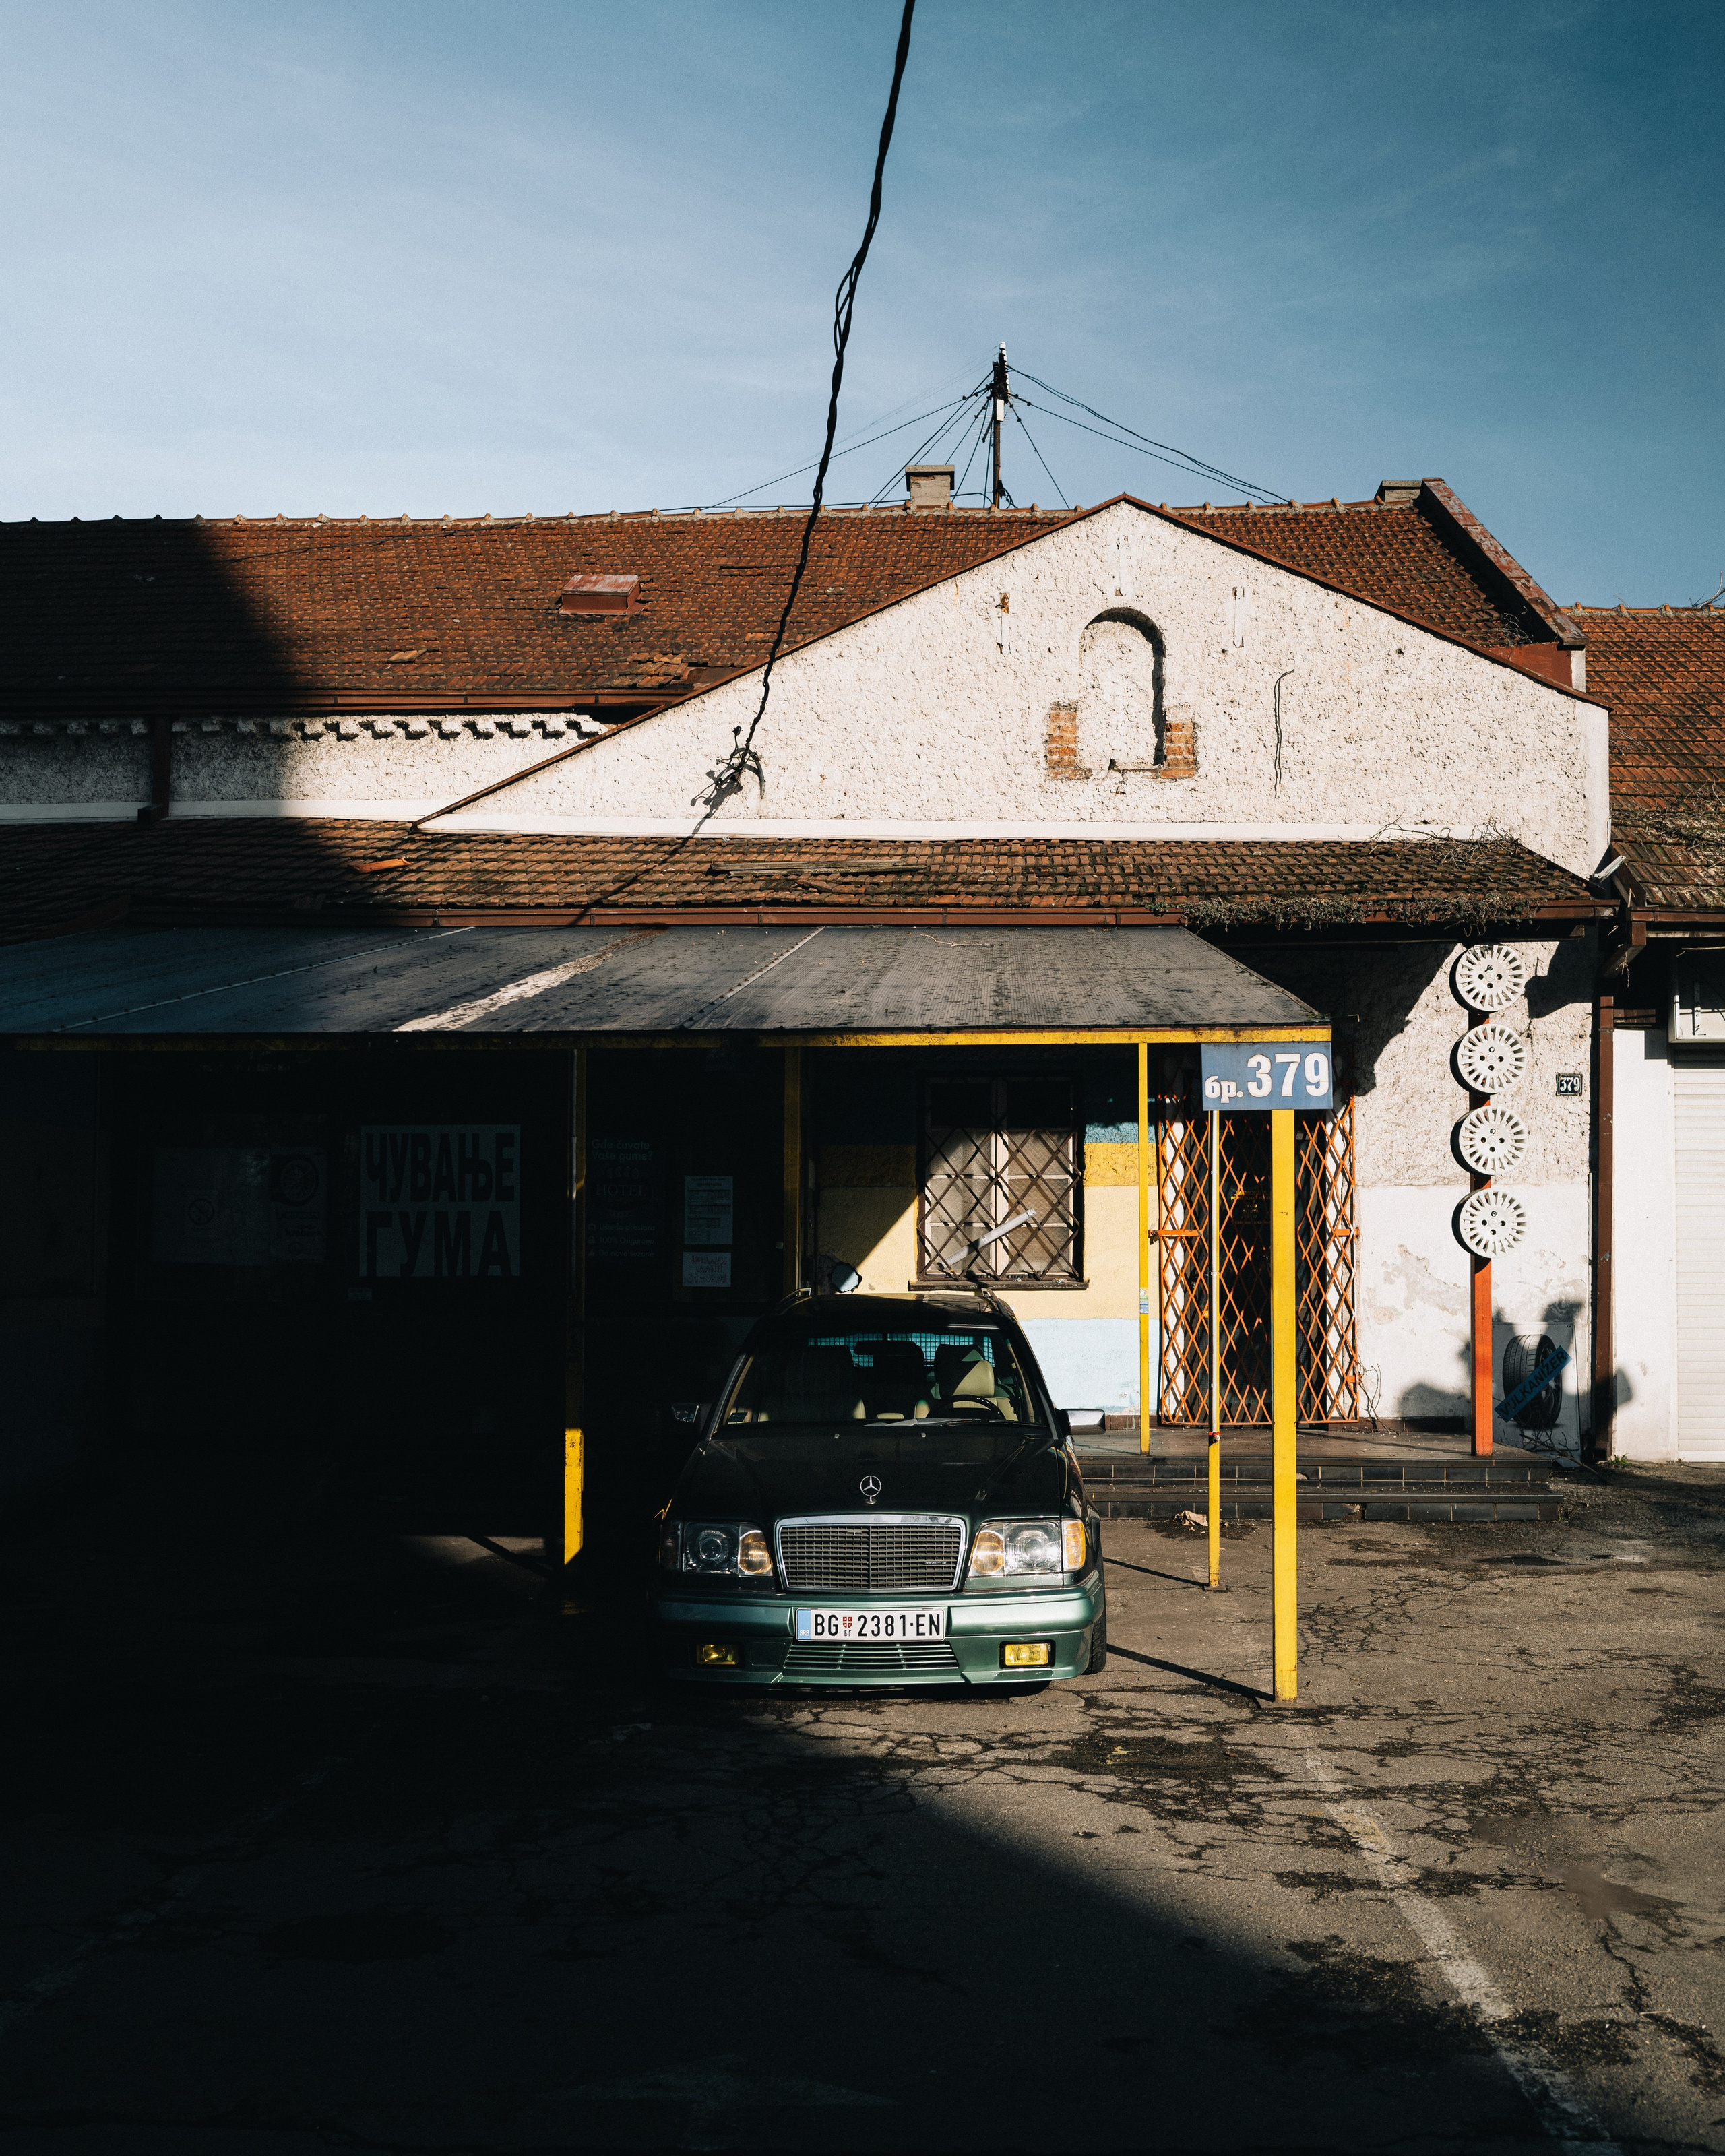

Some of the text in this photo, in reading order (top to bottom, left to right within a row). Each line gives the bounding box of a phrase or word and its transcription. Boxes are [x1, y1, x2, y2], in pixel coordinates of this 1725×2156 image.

[1205, 1052, 1329, 1104] бр. 379
[1560, 1077, 1580, 1091] 379
[592, 1139, 649, 1149] Gde čuvate
[592, 1149, 653, 1163] Vaše gume?
[366, 1133, 515, 1203] ЧУВАЊЕ
[596, 1184, 647, 1197] HOTEL
[367, 1211, 513, 1277] ГУМА
[1499, 1350, 1567, 1416] VULKANIZER
[815, 1614, 839, 1637] BG
